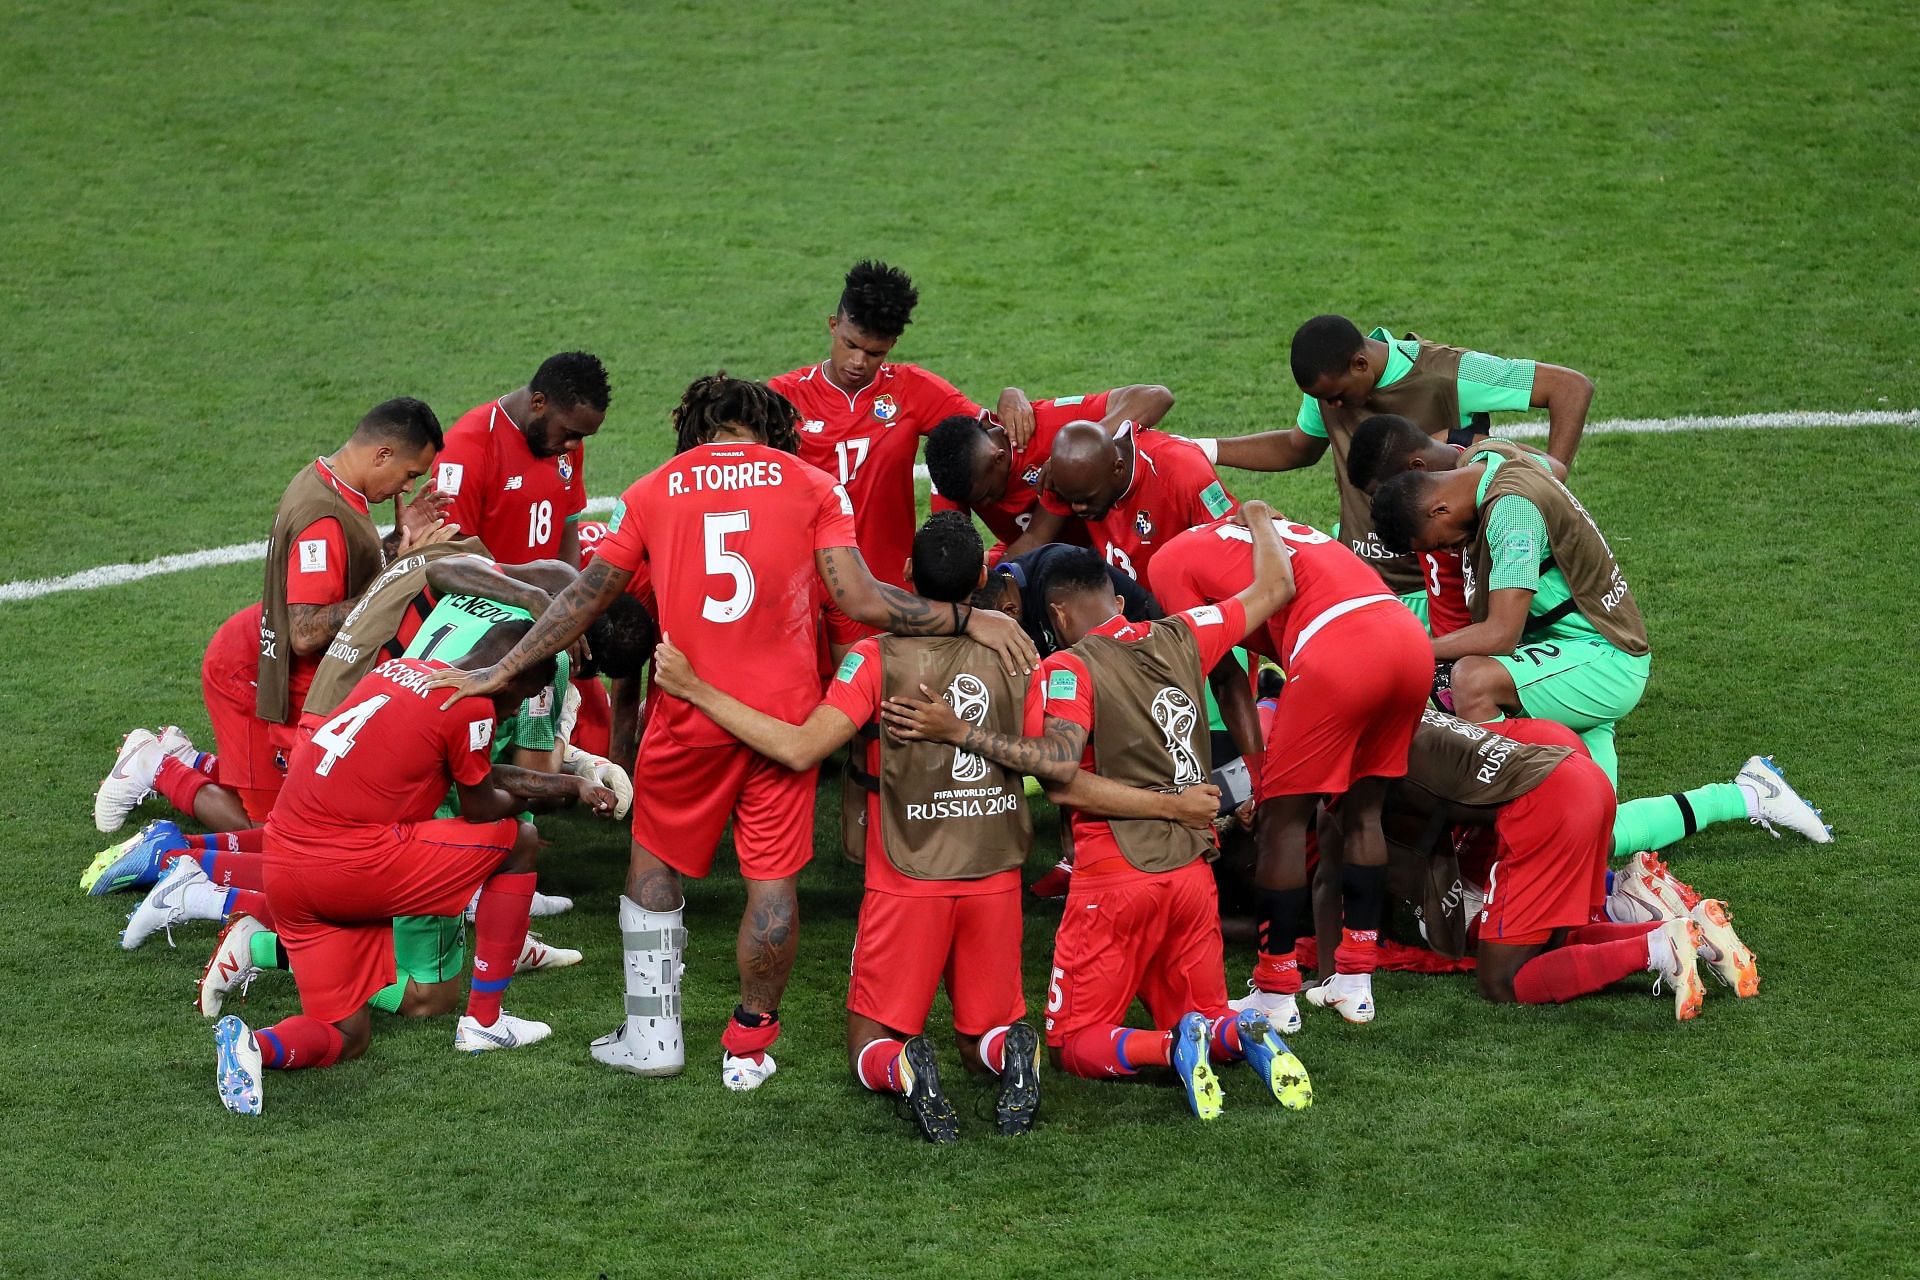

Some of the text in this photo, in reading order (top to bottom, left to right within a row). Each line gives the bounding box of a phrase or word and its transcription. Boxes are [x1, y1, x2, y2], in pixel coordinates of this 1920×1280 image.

[668, 461, 783, 497] R. TORRES
[835, 437, 870, 486] 17
[528, 500, 552, 547] 18
[702, 509, 755, 623] 5
[1352, 540, 1416, 559] RUSS
[418, 622, 459, 663] 1
[1516, 643, 1561, 668] 2
[371, 658, 431, 699] SCOBAR
[311, 693, 392, 777] 4
[907, 794, 1017, 820] RUSSIA 2018
[934, 786, 1003, 800] FIFA WORLD CUP
